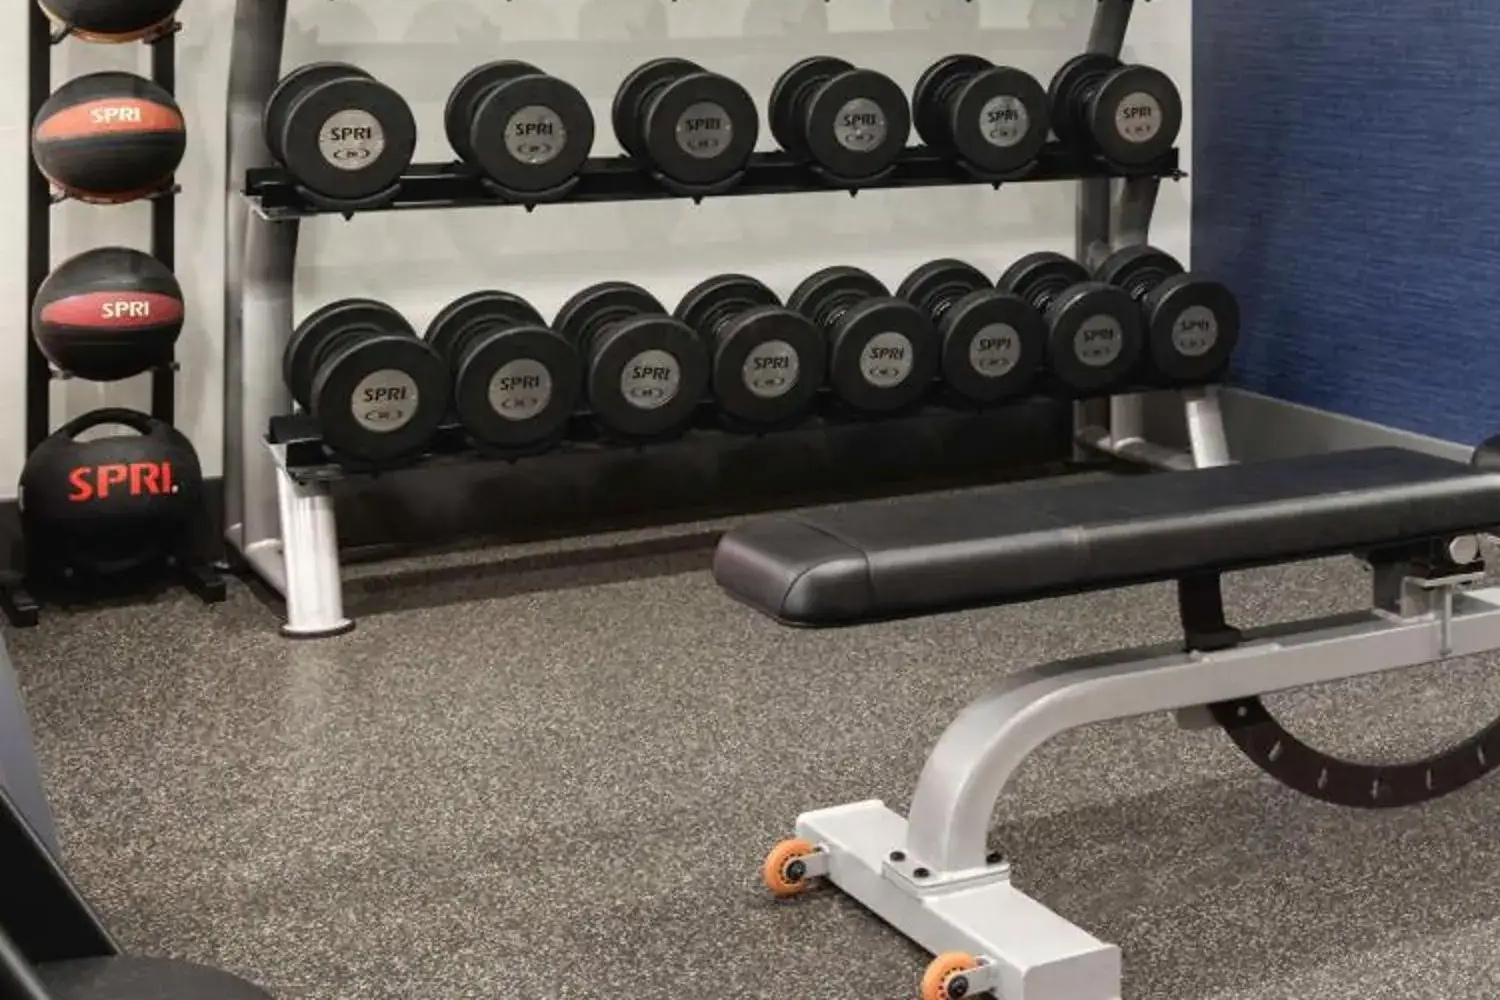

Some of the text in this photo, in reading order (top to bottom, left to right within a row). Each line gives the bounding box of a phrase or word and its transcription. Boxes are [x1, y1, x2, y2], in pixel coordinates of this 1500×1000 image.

[90, 106, 141, 125] SPRI
[843, 113, 876, 127] SPRI
[330, 126, 372, 141] SPRI
[515, 122, 552, 136] SPRI
[101, 300, 150, 320] SPRI
[870, 347, 904, 361] SPRI
[753, 356, 789, 370] SPRI
[631, 365, 671, 381] SPRI
[500, 376, 539, 391] SPRI
[363, 387, 406, 402] SPRI
